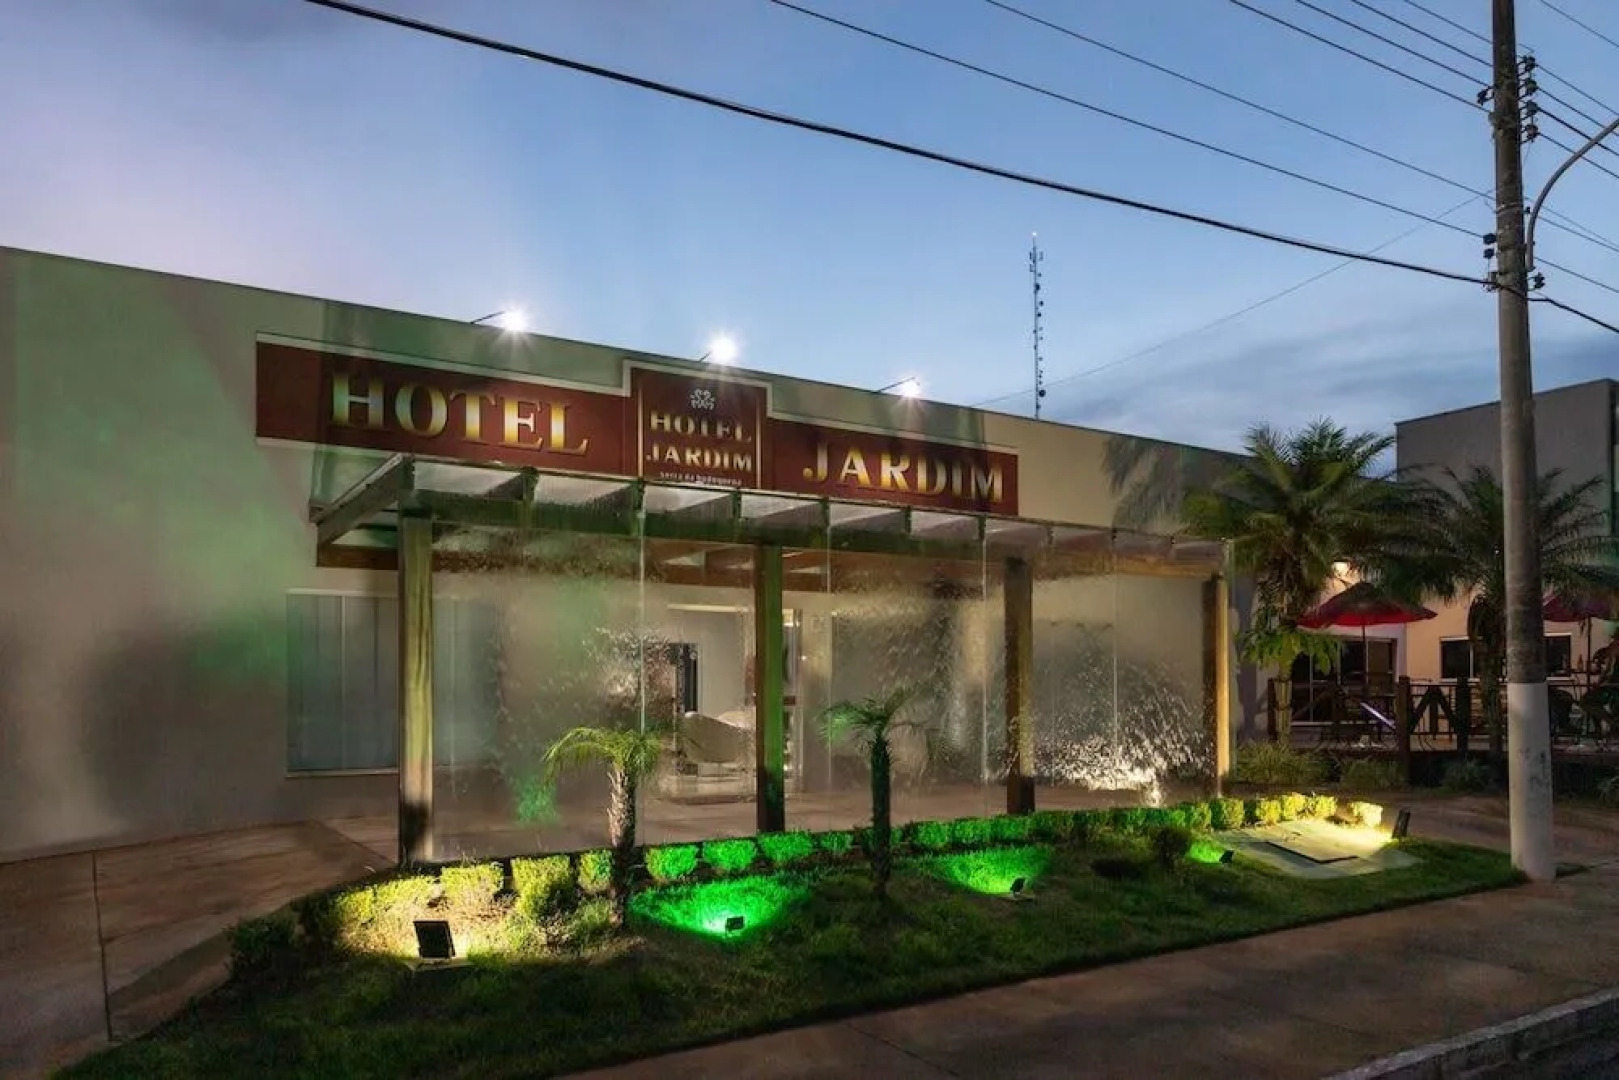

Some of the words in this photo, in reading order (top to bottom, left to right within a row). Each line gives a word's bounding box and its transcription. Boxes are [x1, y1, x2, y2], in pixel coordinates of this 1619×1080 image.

[330, 371, 589, 455] HOTEL
[649, 410, 752, 443] HOTEL
[645, 442, 752, 472] JARDIM
[802, 439, 1003, 503] JARDIM
